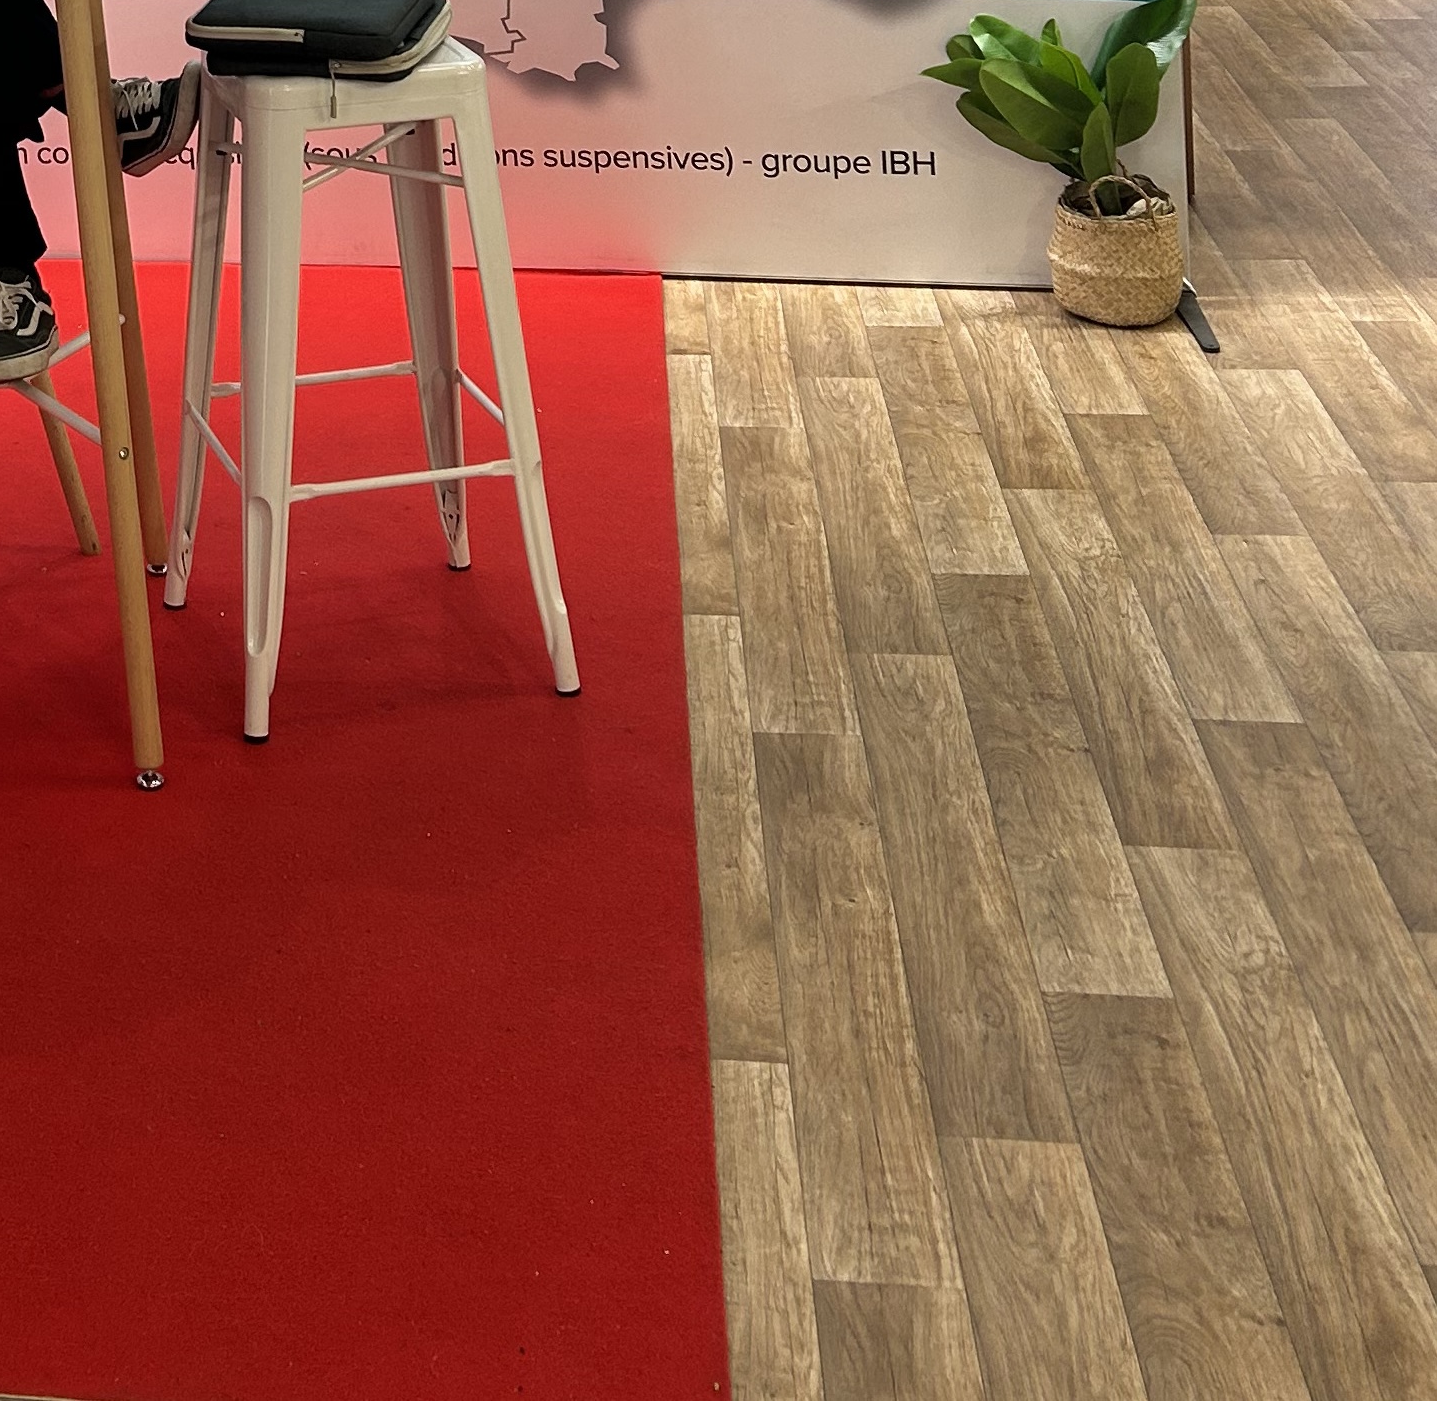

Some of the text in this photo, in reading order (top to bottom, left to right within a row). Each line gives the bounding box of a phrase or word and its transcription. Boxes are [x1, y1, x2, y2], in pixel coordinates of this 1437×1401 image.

[543, 145, 734, 177] suspensives)
[762, 149, 872, 178] groupe
[881, 150, 936, 176] IBH
